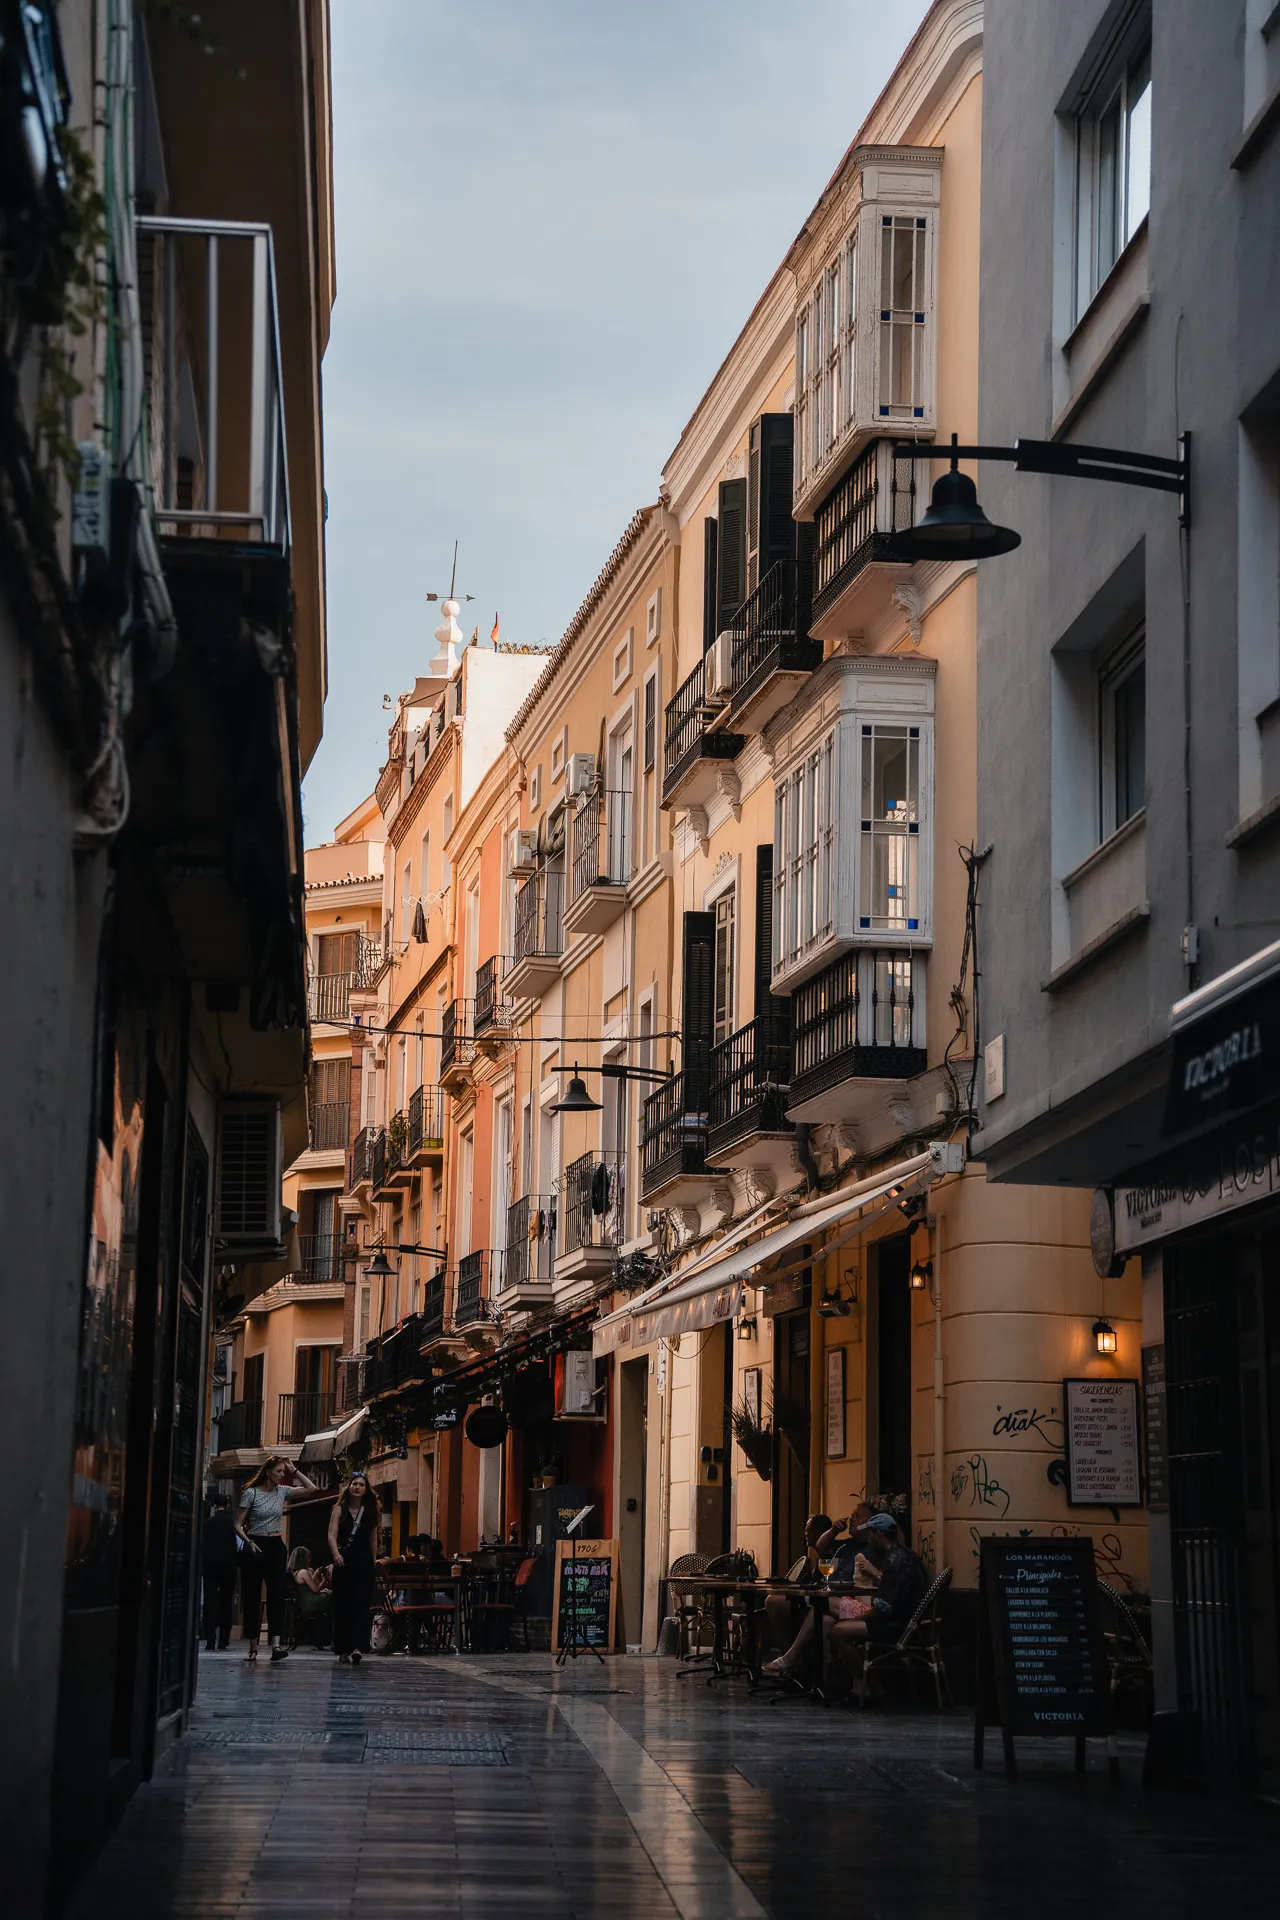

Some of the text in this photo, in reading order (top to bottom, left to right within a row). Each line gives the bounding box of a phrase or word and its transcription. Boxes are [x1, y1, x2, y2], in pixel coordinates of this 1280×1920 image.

[1184, 1022, 1261, 1091] VICTORIA
[1079, 1386, 1123, 1395] SUGERENCIAS
[577, 1545, 597, 1553] 1906
[1017, 1568, 1062, 1584] Principales
[1034, 1712, 1085, 1721] VICTORIA
